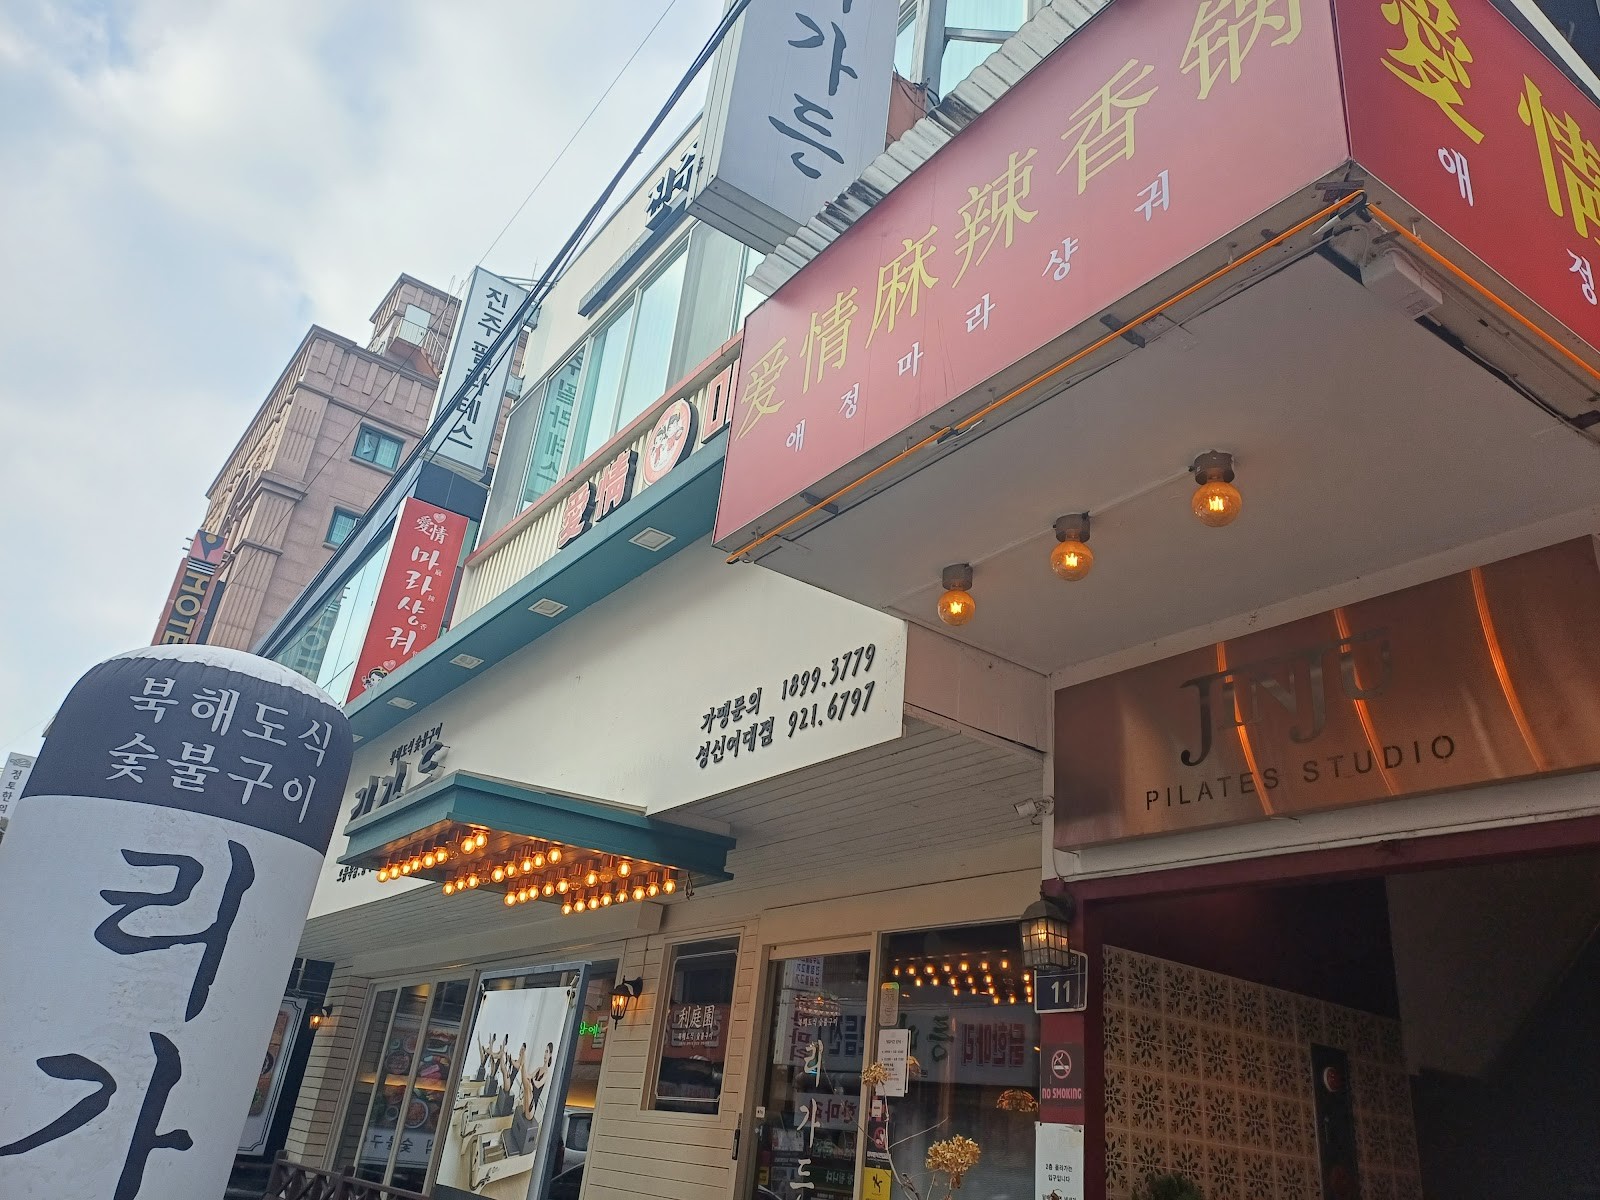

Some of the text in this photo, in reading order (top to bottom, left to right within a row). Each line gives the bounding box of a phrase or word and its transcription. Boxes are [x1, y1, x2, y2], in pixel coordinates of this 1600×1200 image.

[768, 0, 858, 180] 가든
[130, 676, 334, 768] 북해도식
[695, 681, 876, 768] 성신여대점 921.6797
[701, 643, 876, 733] 가맹문의 1899.3779
[105, 732, 316, 824] 숯불구이
[1145, 734, 1456, 811] PILATES STUDIO
[1051, 980, 1070, 1004] 11
[1041, 1088, 1082, 1100] NO SMOKING
